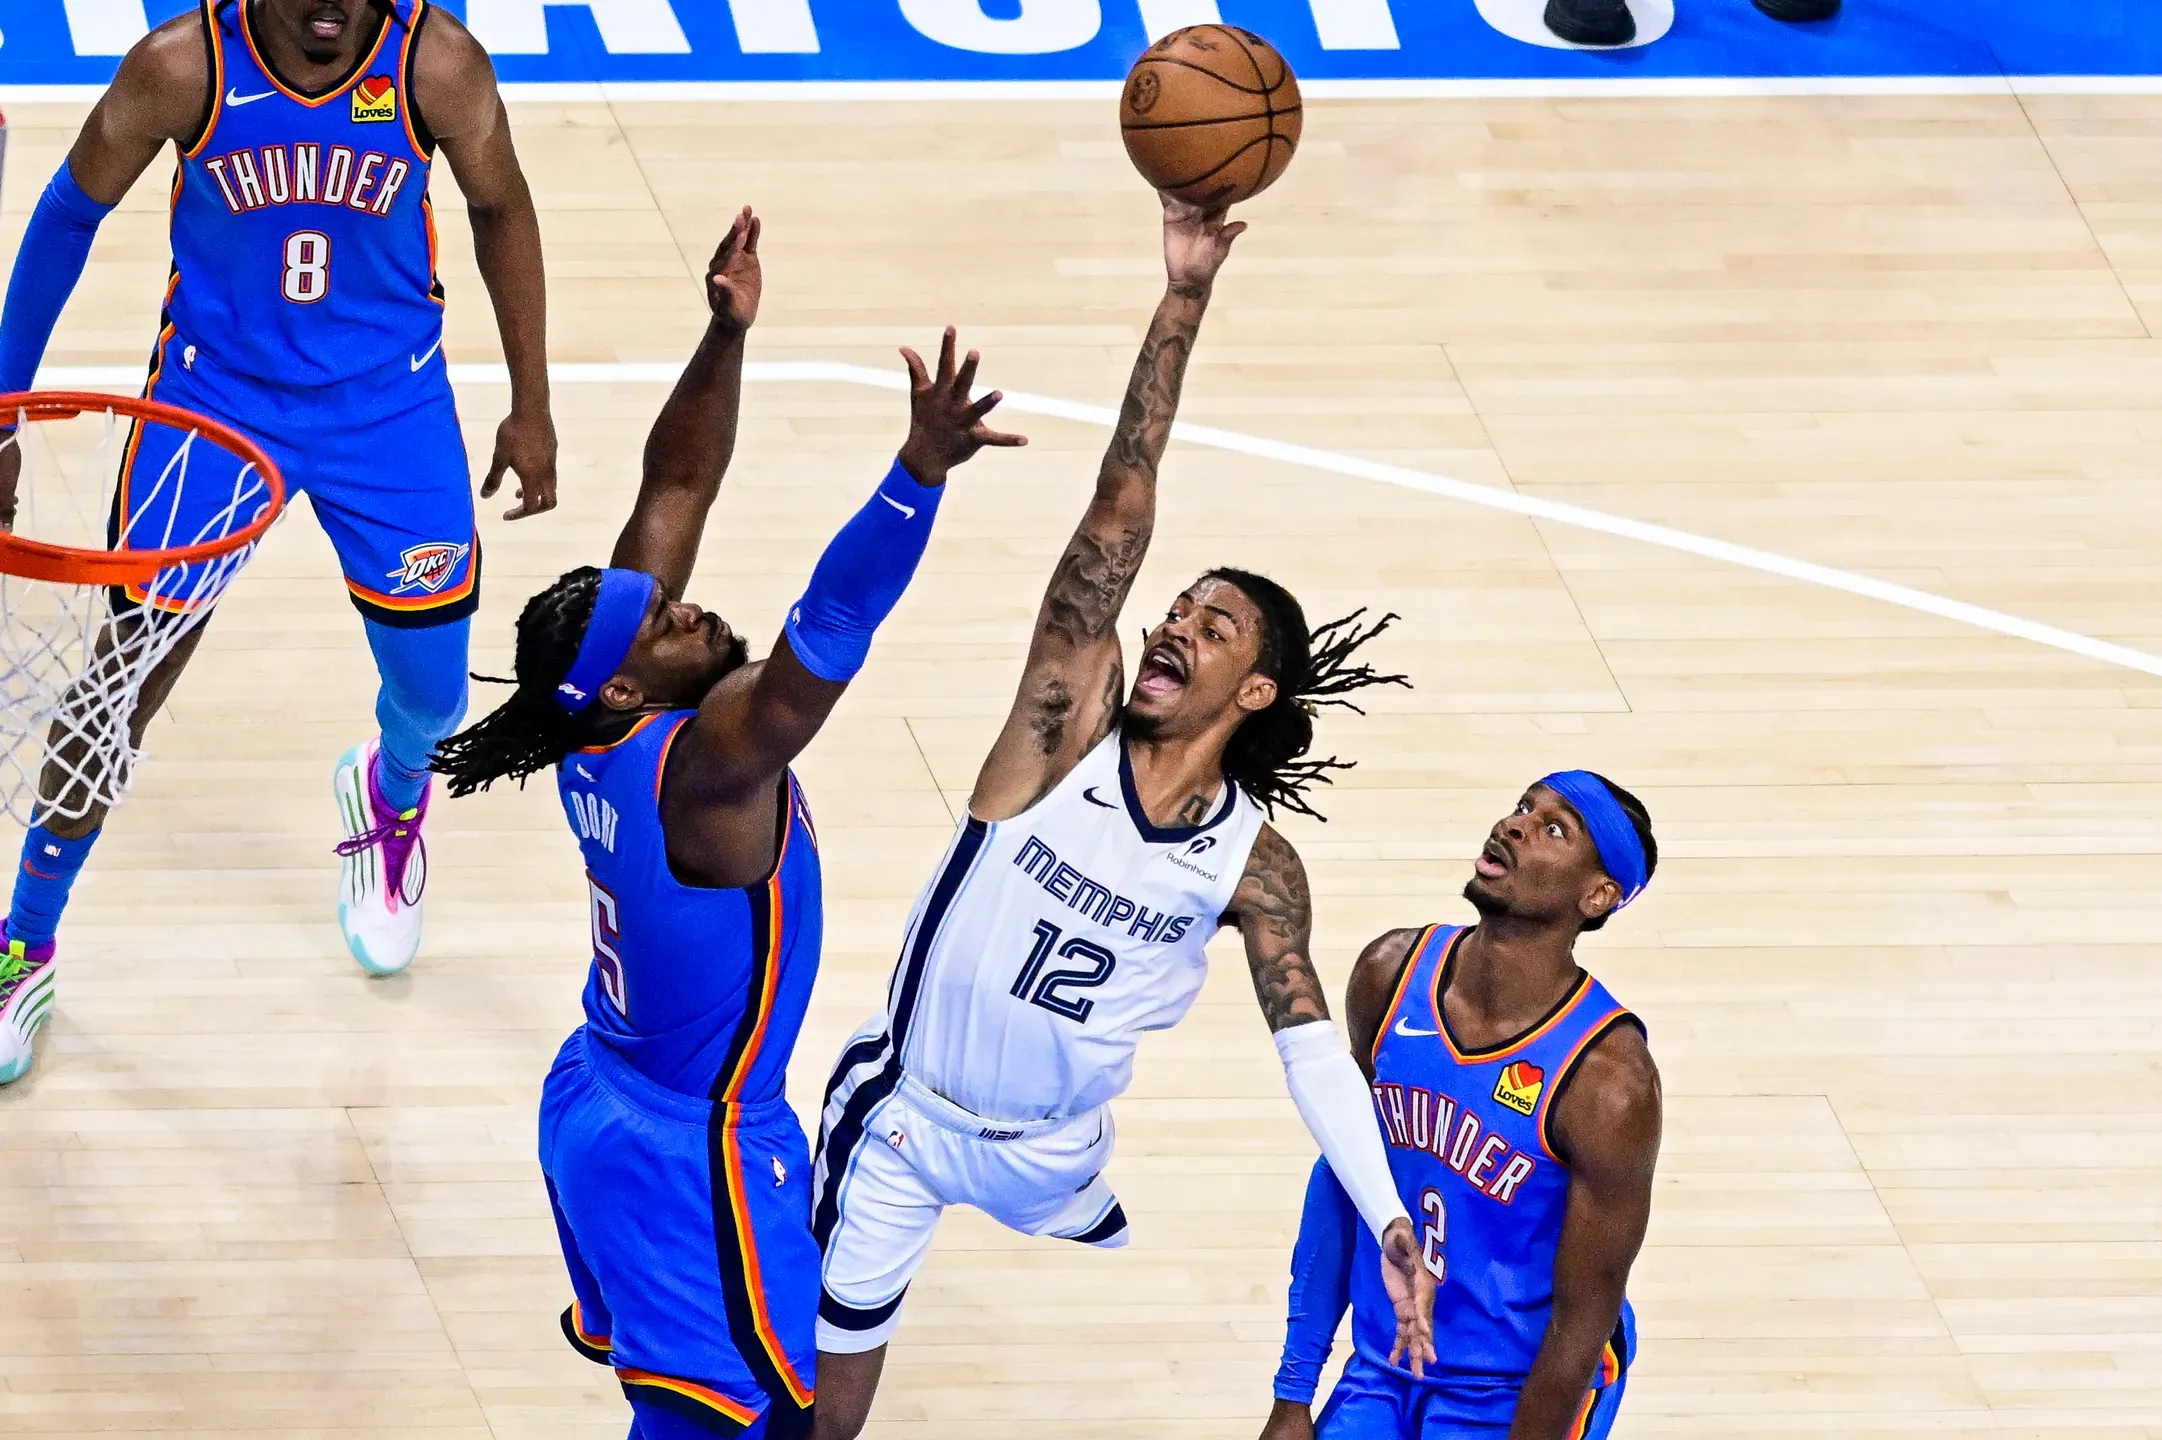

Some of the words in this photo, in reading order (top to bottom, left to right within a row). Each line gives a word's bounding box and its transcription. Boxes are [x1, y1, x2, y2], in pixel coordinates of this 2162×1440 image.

[205, 142, 410, 217] THUNDER
[281, 230, 331, 304] 8
[404, 551, 448, 583] OKC
[571, 791, 619, 853] DORT
[1013, 835, 1195, 943] MEMPHIS
[1166, 852, 1218, 882] Robinhood
[587, 868, 628, 1021] 5
[1009, 918, 1116, 1025] 12
[1373, 1082, 1536, 1206] THUNDER
[1421, 1187, 1447, 1286] 2
